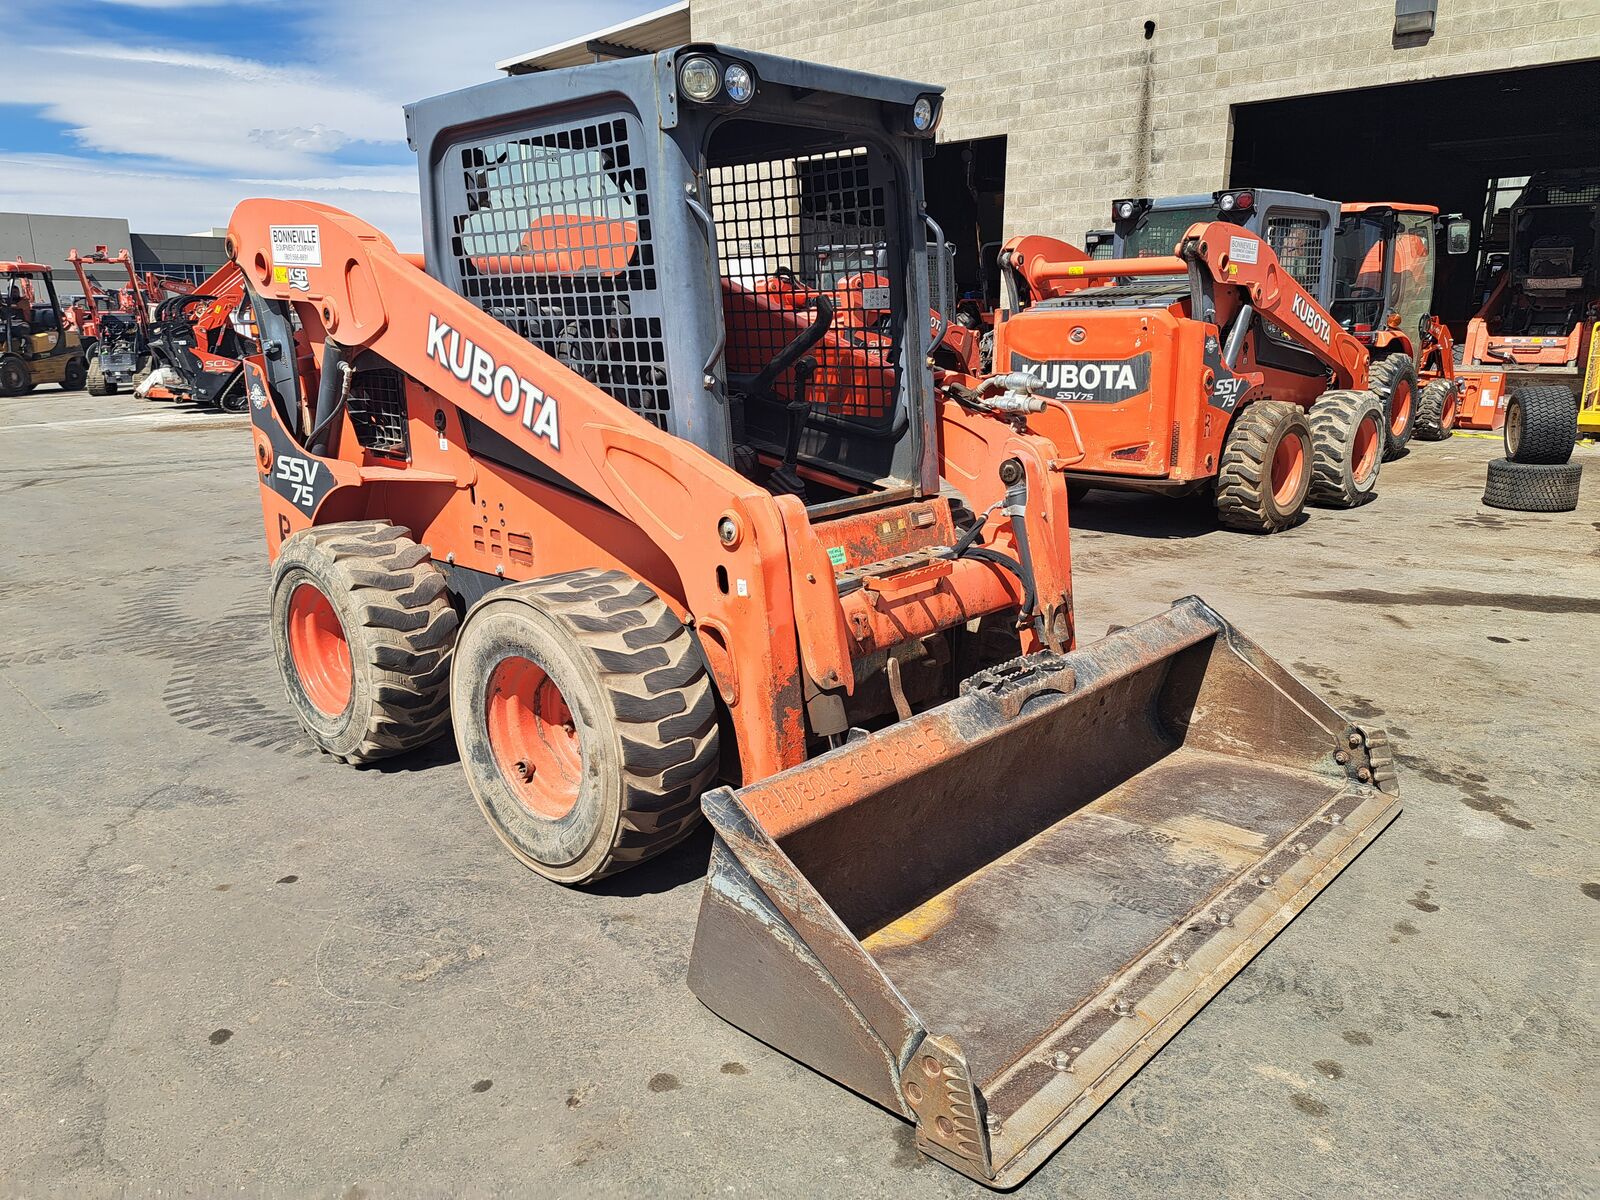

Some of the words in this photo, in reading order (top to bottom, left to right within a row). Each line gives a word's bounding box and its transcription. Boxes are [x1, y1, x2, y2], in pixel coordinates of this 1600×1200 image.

[273, 230, 316, 243] BONNEVILLE
[296, 244, 316, 252] COMPANY
[288, 268, 308, 280] KSR
[1291, 292, 1331, 345] KUBOTA
[426, 312, 561, 451] KUBOTA
[1214, 378, 1243, 396] SSV
[1221, 394, 1237, 408] 75
[276, 455, 319, 485] SSV
[290, 483, 314, 507] 75
